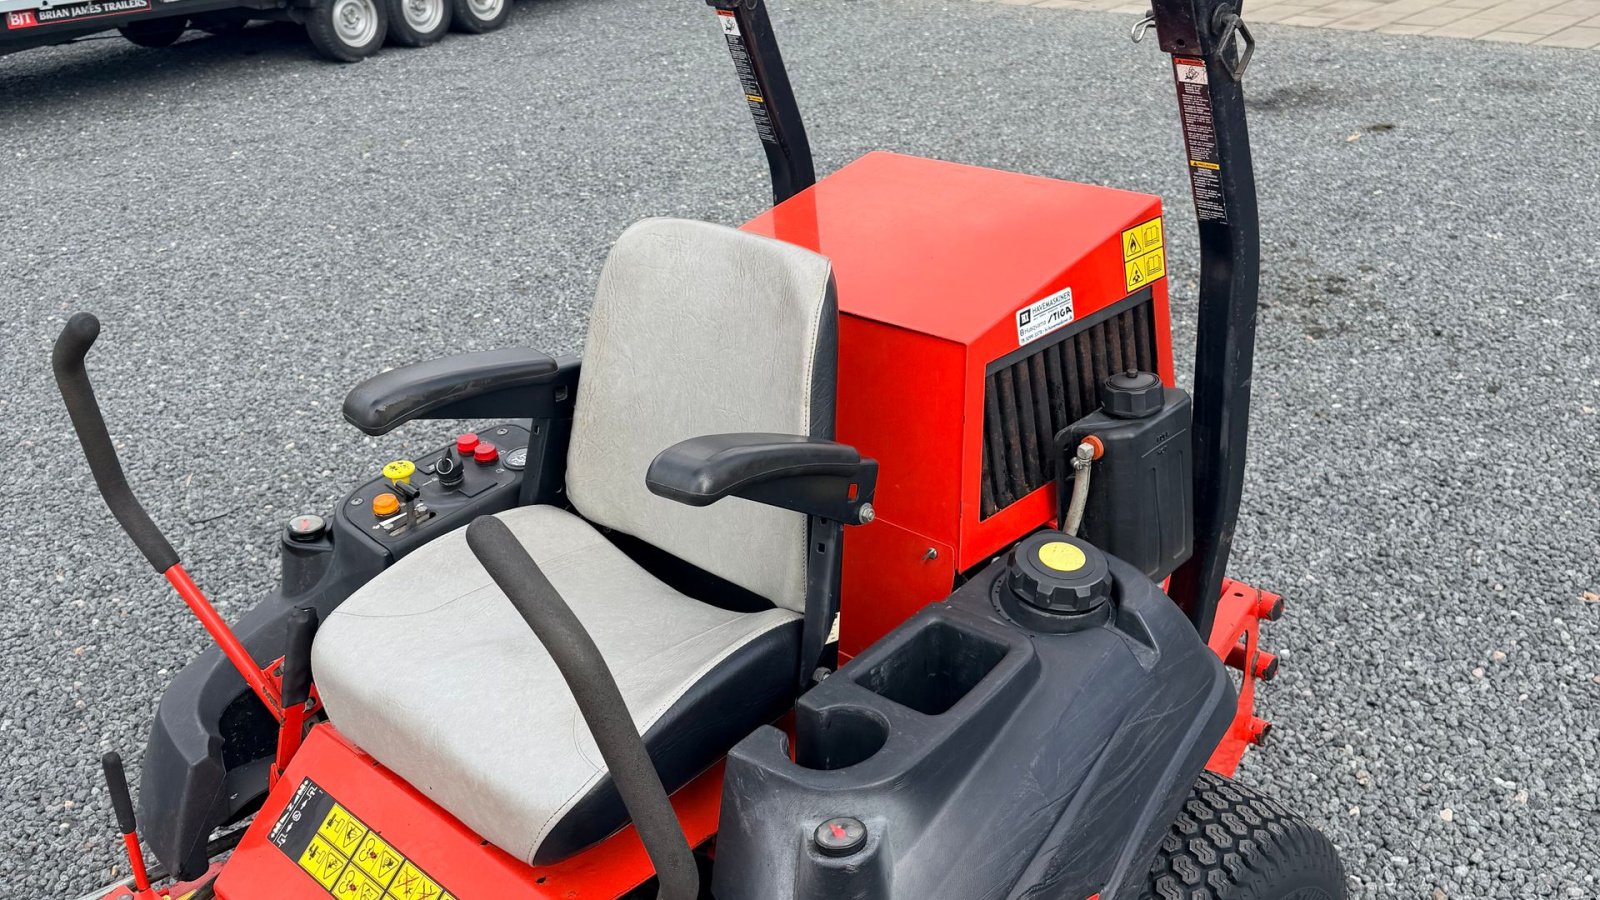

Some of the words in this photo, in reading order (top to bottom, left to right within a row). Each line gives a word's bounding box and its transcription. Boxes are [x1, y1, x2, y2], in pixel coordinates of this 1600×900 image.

[39, 8, 70, 20] BRIAN
[71, 5, 101, 17] JAMES
[103, 0, 147, 11] TRAILERS
[1033, 291, 1070, 313] HAVEMASKINER
